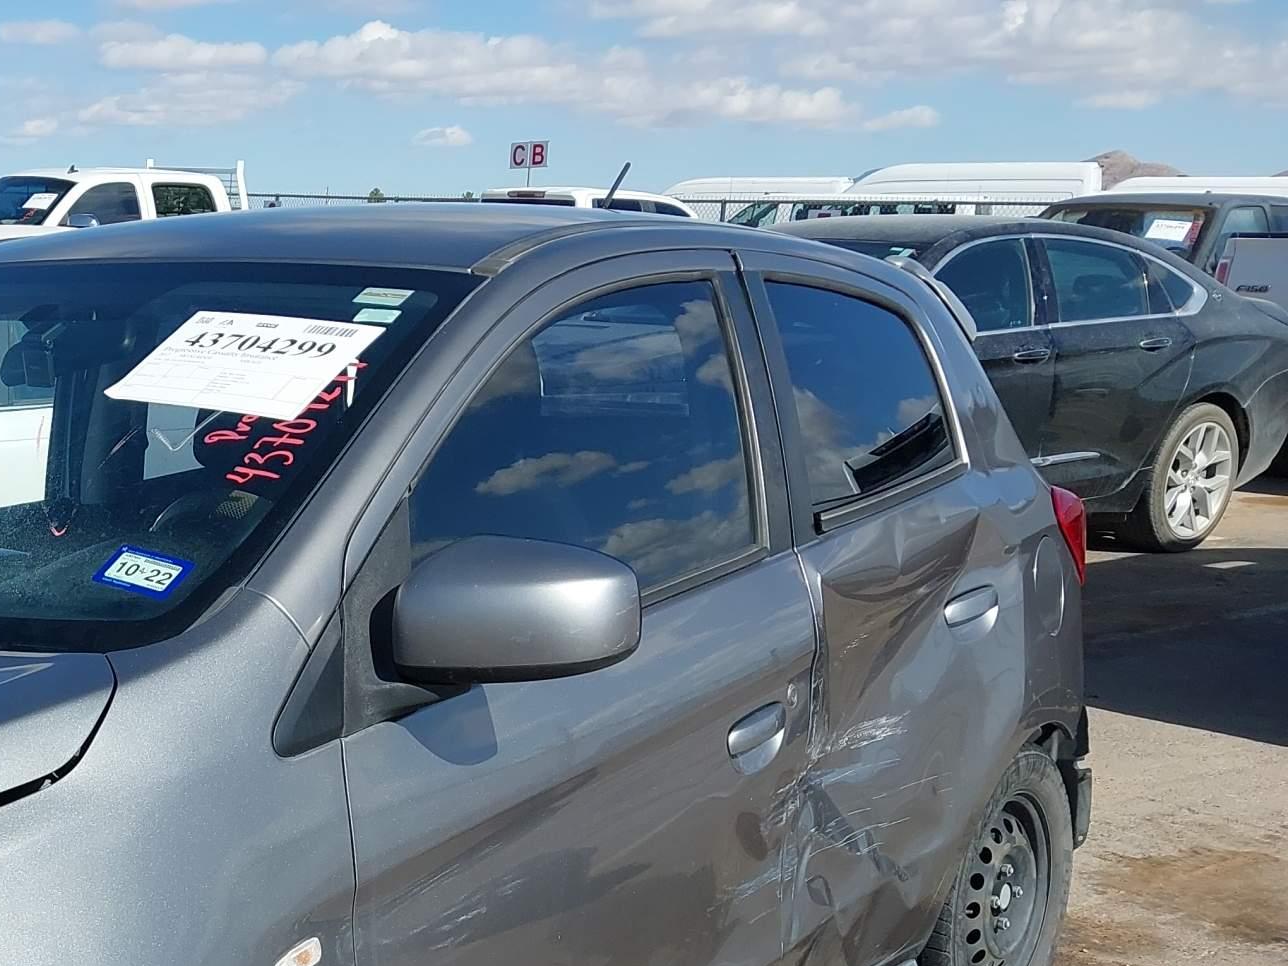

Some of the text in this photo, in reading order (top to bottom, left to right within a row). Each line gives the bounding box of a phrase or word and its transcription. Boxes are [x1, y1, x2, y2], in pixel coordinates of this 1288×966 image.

[512, 143, 545, 166] C B
[184, 331, 337, 358] 43704299
[116, 561, 141, 577] 10
[143, 568, 173, 586] 22
